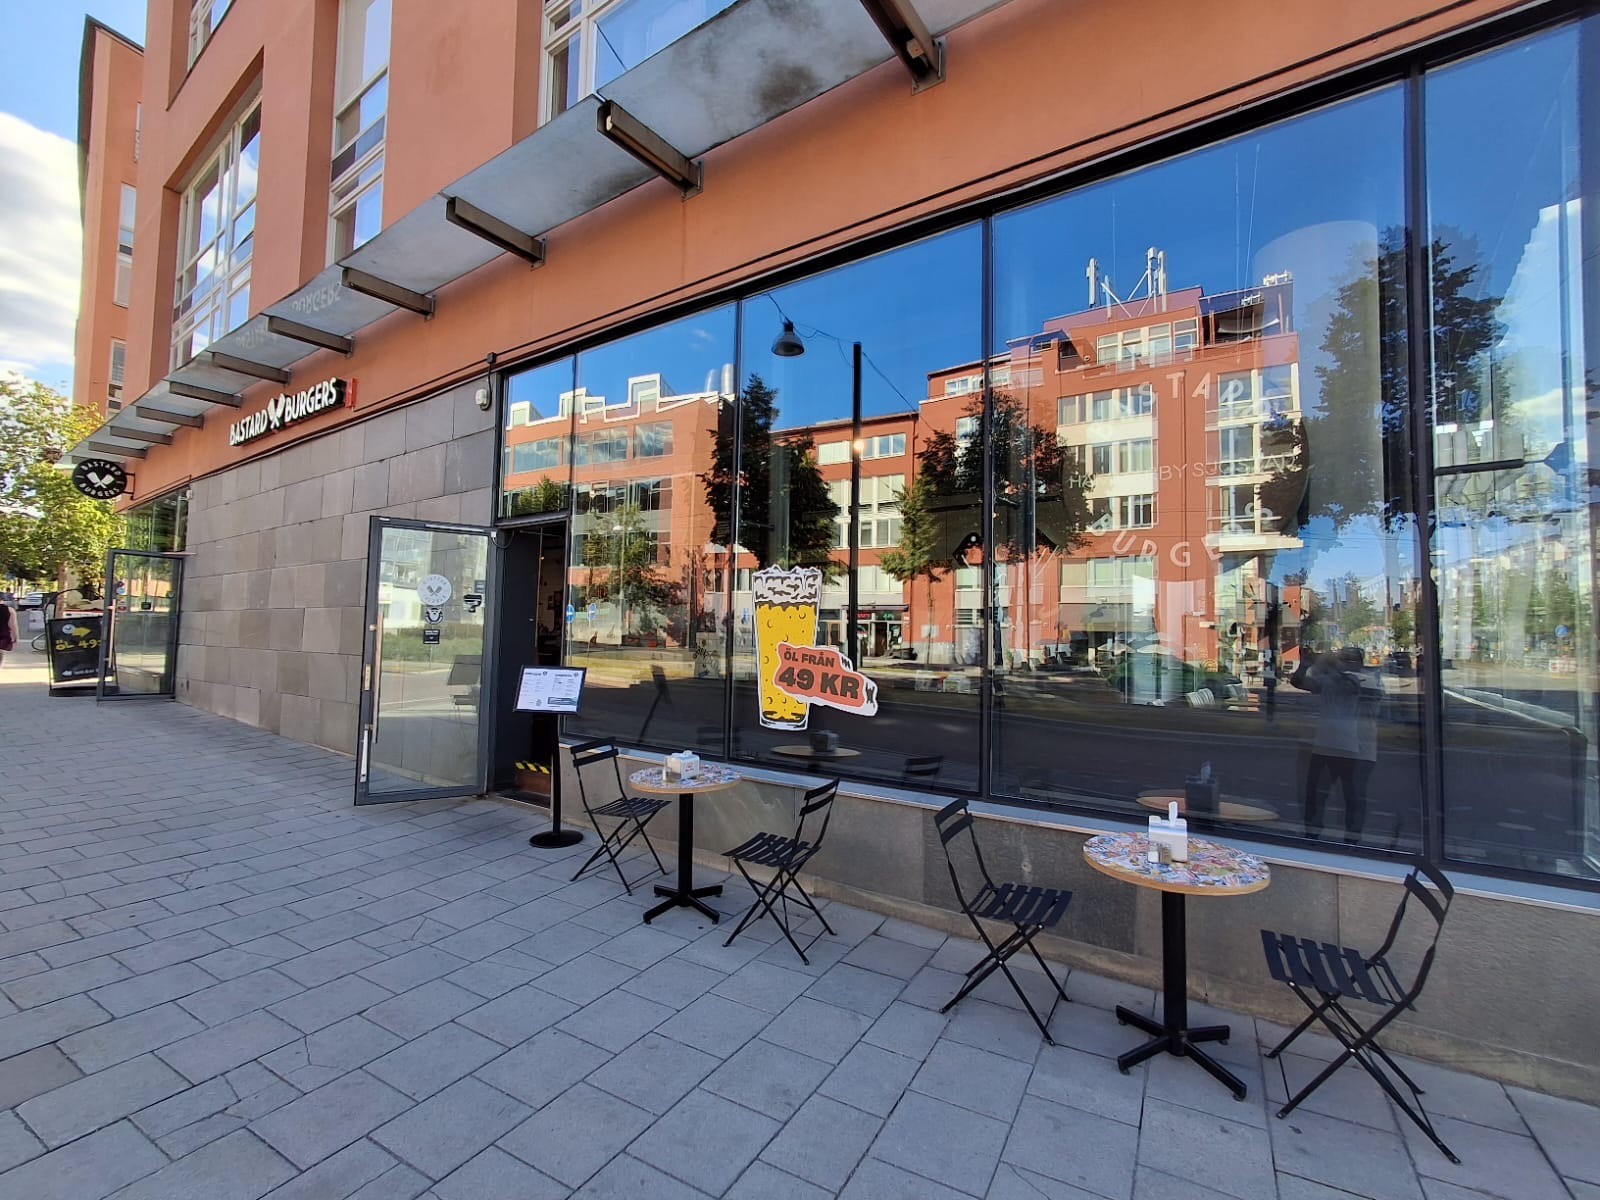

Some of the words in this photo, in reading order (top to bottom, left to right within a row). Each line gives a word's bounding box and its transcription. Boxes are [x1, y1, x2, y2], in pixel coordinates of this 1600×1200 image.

[229, 409, 268, 446] BASTARD
[284, 376, 337, 423] BURGERS
[79, 482, 120, 497] BURGERS
[784, 647, 798, 661] ÖL
[801, 651, 835, 668] FRÅN
[779, 666, 815, 690] 49
[820, 672, 860, 699] KR
